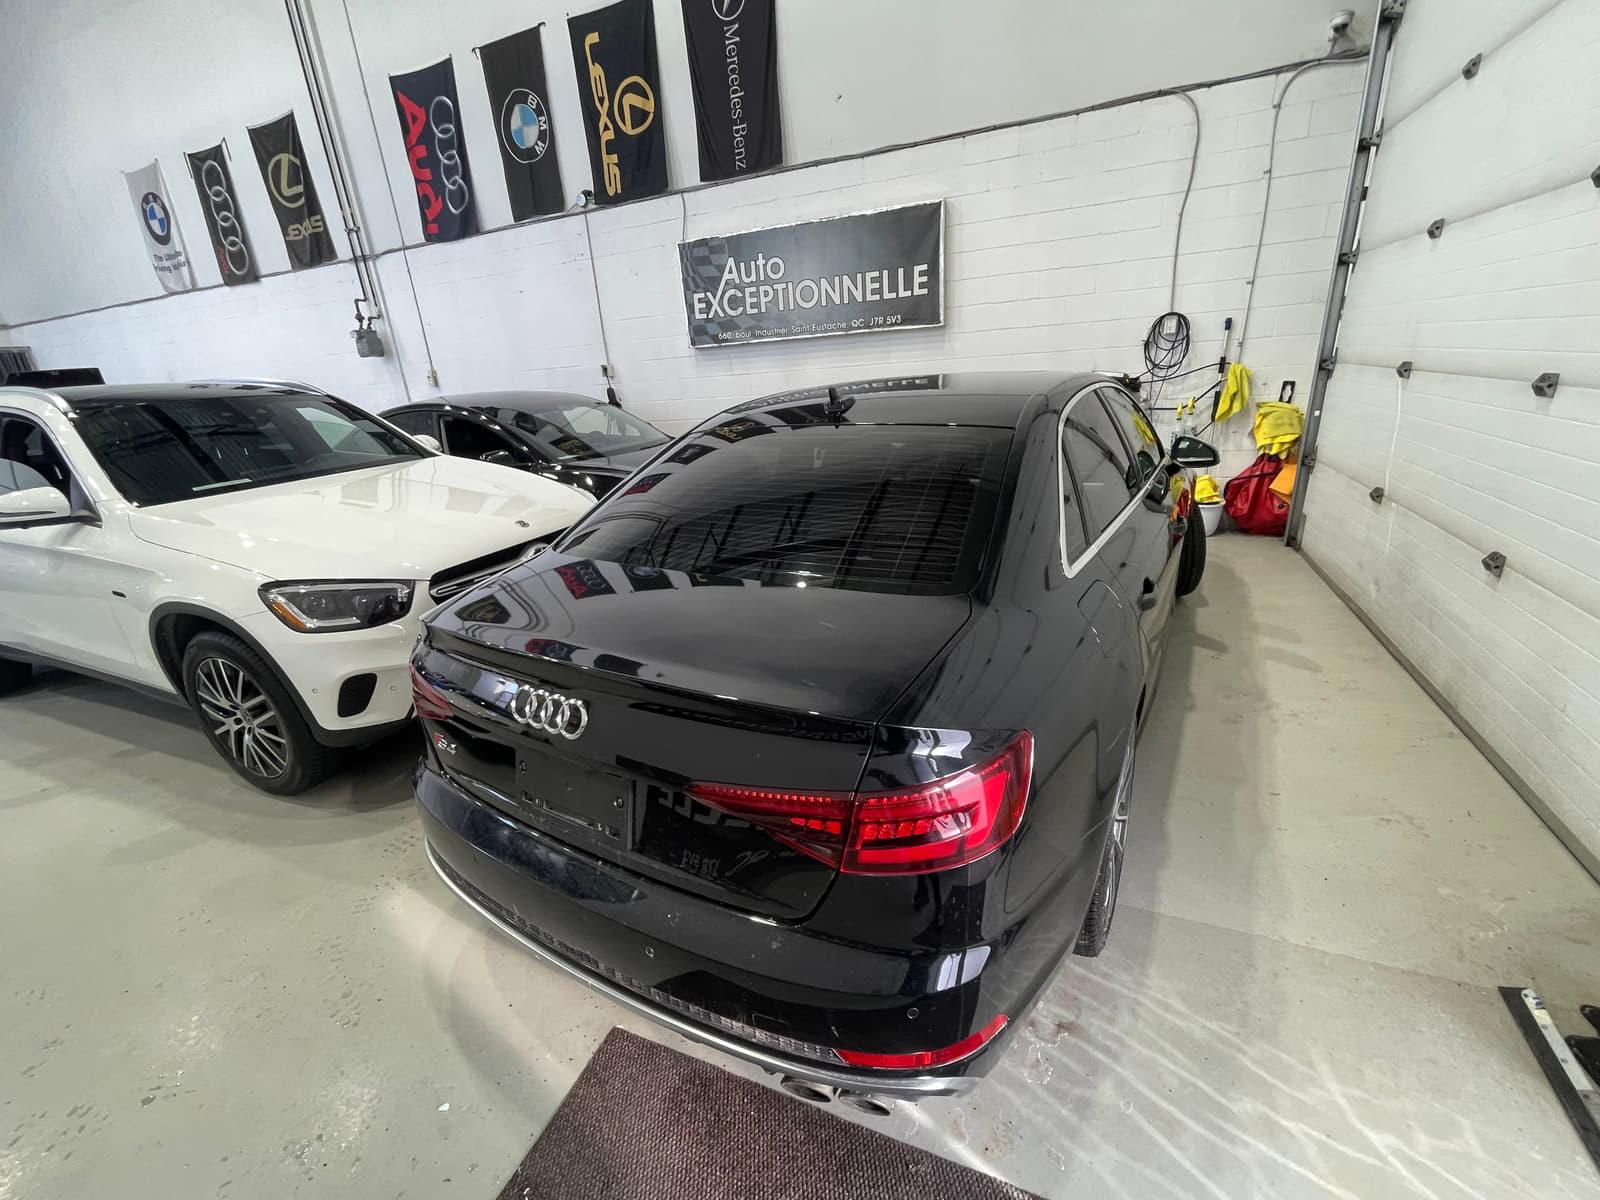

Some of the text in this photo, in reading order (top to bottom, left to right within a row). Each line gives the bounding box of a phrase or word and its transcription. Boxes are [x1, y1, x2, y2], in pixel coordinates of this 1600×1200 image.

[526, 94, 547, 155] BMW
[585, 32, 622, 197] LEXUS
[723, 22, 747, 170] Mercedes-Benz
[693, 263, 929, 320] EXCEPTIONNELLE
[720, 252, 785, 286] Auto
[851, 318, 865, 328] QC
[869, 316, 884, 326] J7R
[886, 314, 902, 324] 5V3
